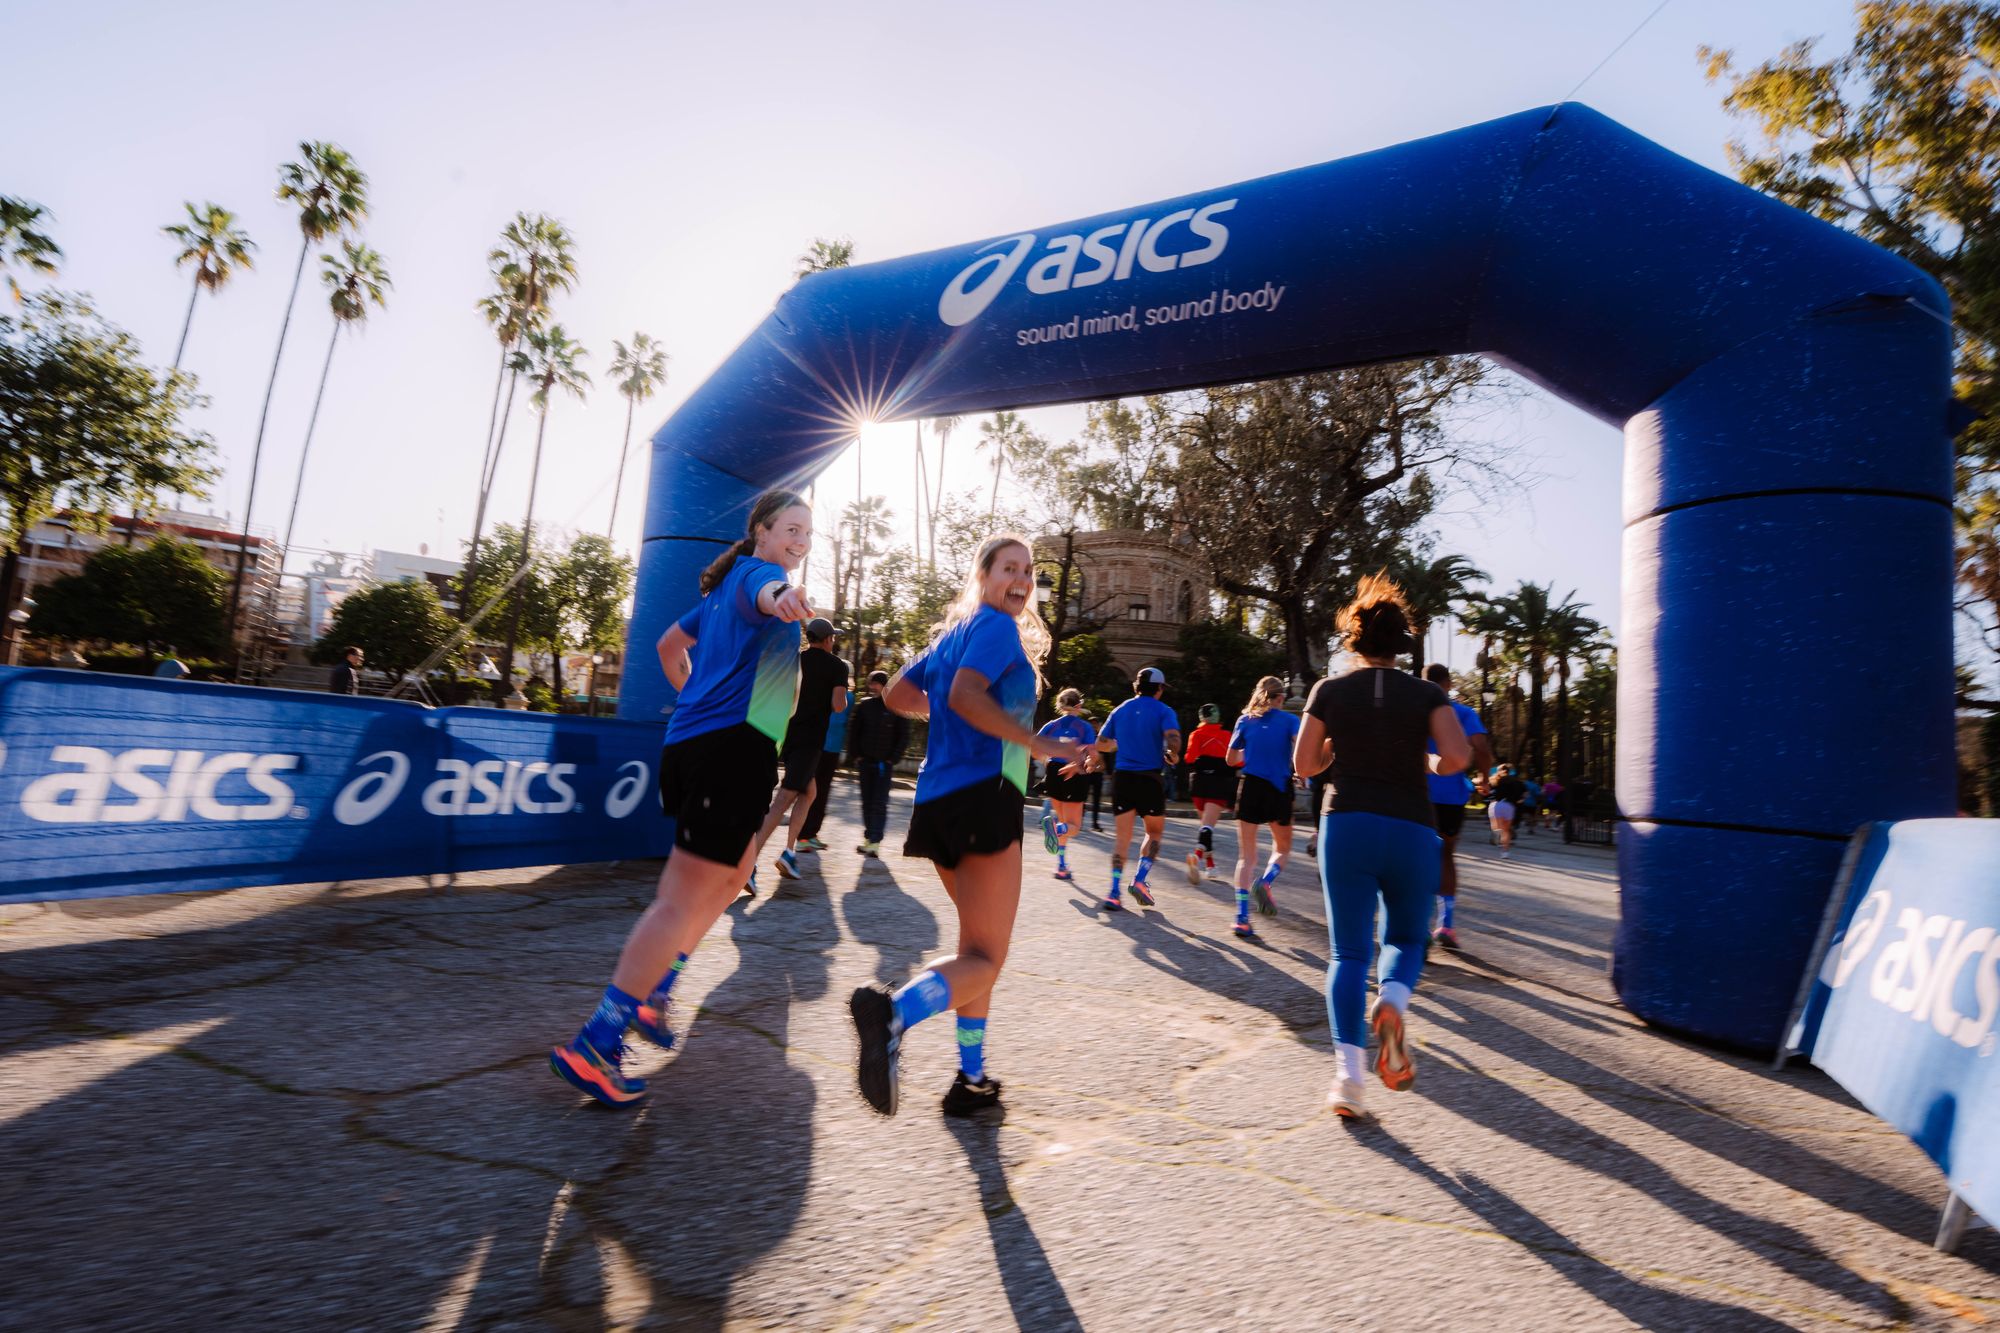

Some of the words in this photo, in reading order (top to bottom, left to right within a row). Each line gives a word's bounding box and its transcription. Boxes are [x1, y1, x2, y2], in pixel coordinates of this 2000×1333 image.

[1026, 198, 1239, 295] asics
[1016, 316, 1079, 346] sound
[1083, 306, 1140, 336] mind,
[1144, 291, 1217, 326] sound
[1220, 281, 1285, 312] body
[20, 745, 299, 822] asics
[421, 758, 577, 816] asics
